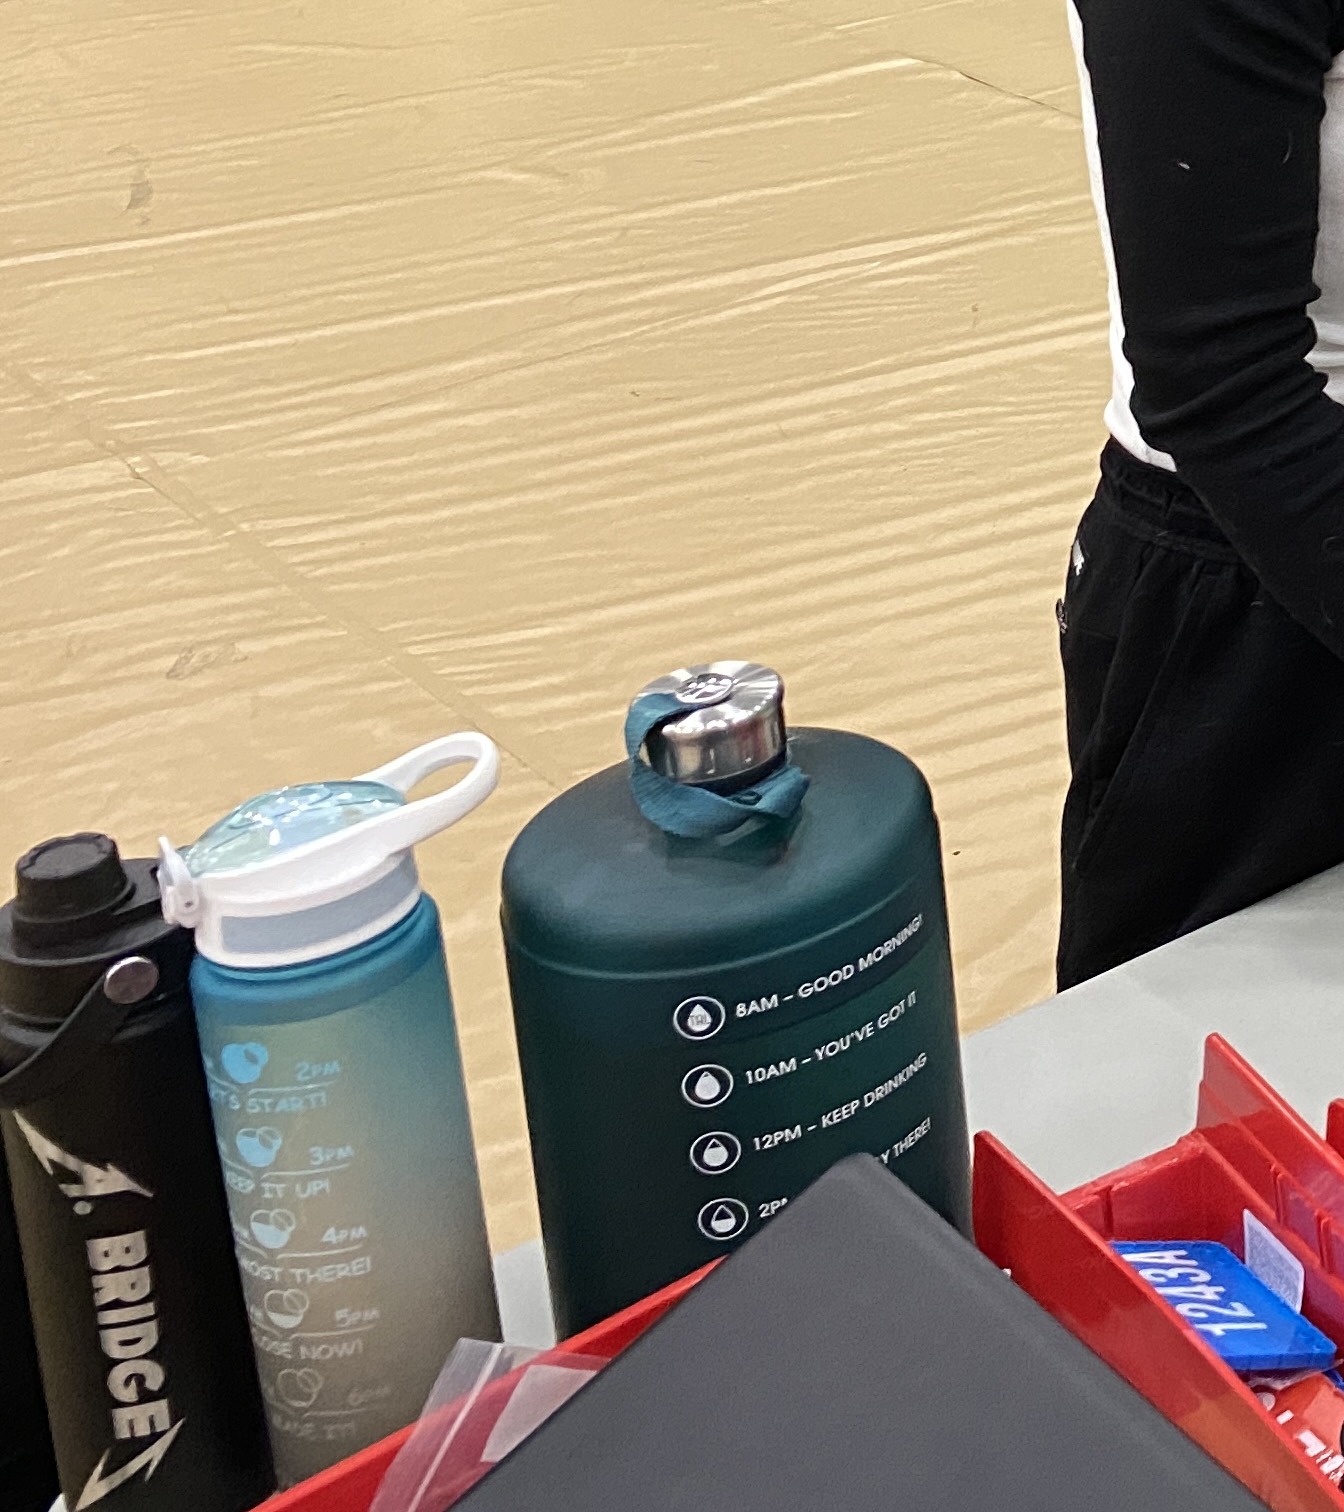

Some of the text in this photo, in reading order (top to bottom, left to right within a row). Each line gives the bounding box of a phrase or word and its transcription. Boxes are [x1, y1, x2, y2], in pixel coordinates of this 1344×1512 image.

[735, 994, 779, 1018] 8AM
[797, 963, 855, 998] GOOD
[858, 913, 923, 972] MORNING!
[745, 1057, 798, 1085] 10AM
[814, 1021, 875, 1061] YOU'VE
[877, 1000, 906, 1030] GOT
[907, 991, 918, 1008] IT
[296, 1060, 341, 1081] 2PM
[246, 1091, 327, 1113] START!
[752, 1124, 802, 1151] 12PM
[821, 1099, 860, 1129] KEEP
[863, 1052, 927, 1108] DRINKING
[893, 1117, 932, 1158] THERE!
[309, 1145, 354, 1165] 3PM
[758, 1197, 788, 1218] 2P
[322, 1226, 367, 1244] 4PM
[290, 1256, 371, 1284] THERE!
[1121, 1249, 1268, 1336] 1243A
[335, 1307, 380, 1327] 5PM
[86, 1230, 171, 1440] BRIDGE
[300, 1339, 364, 1360] NOW!
